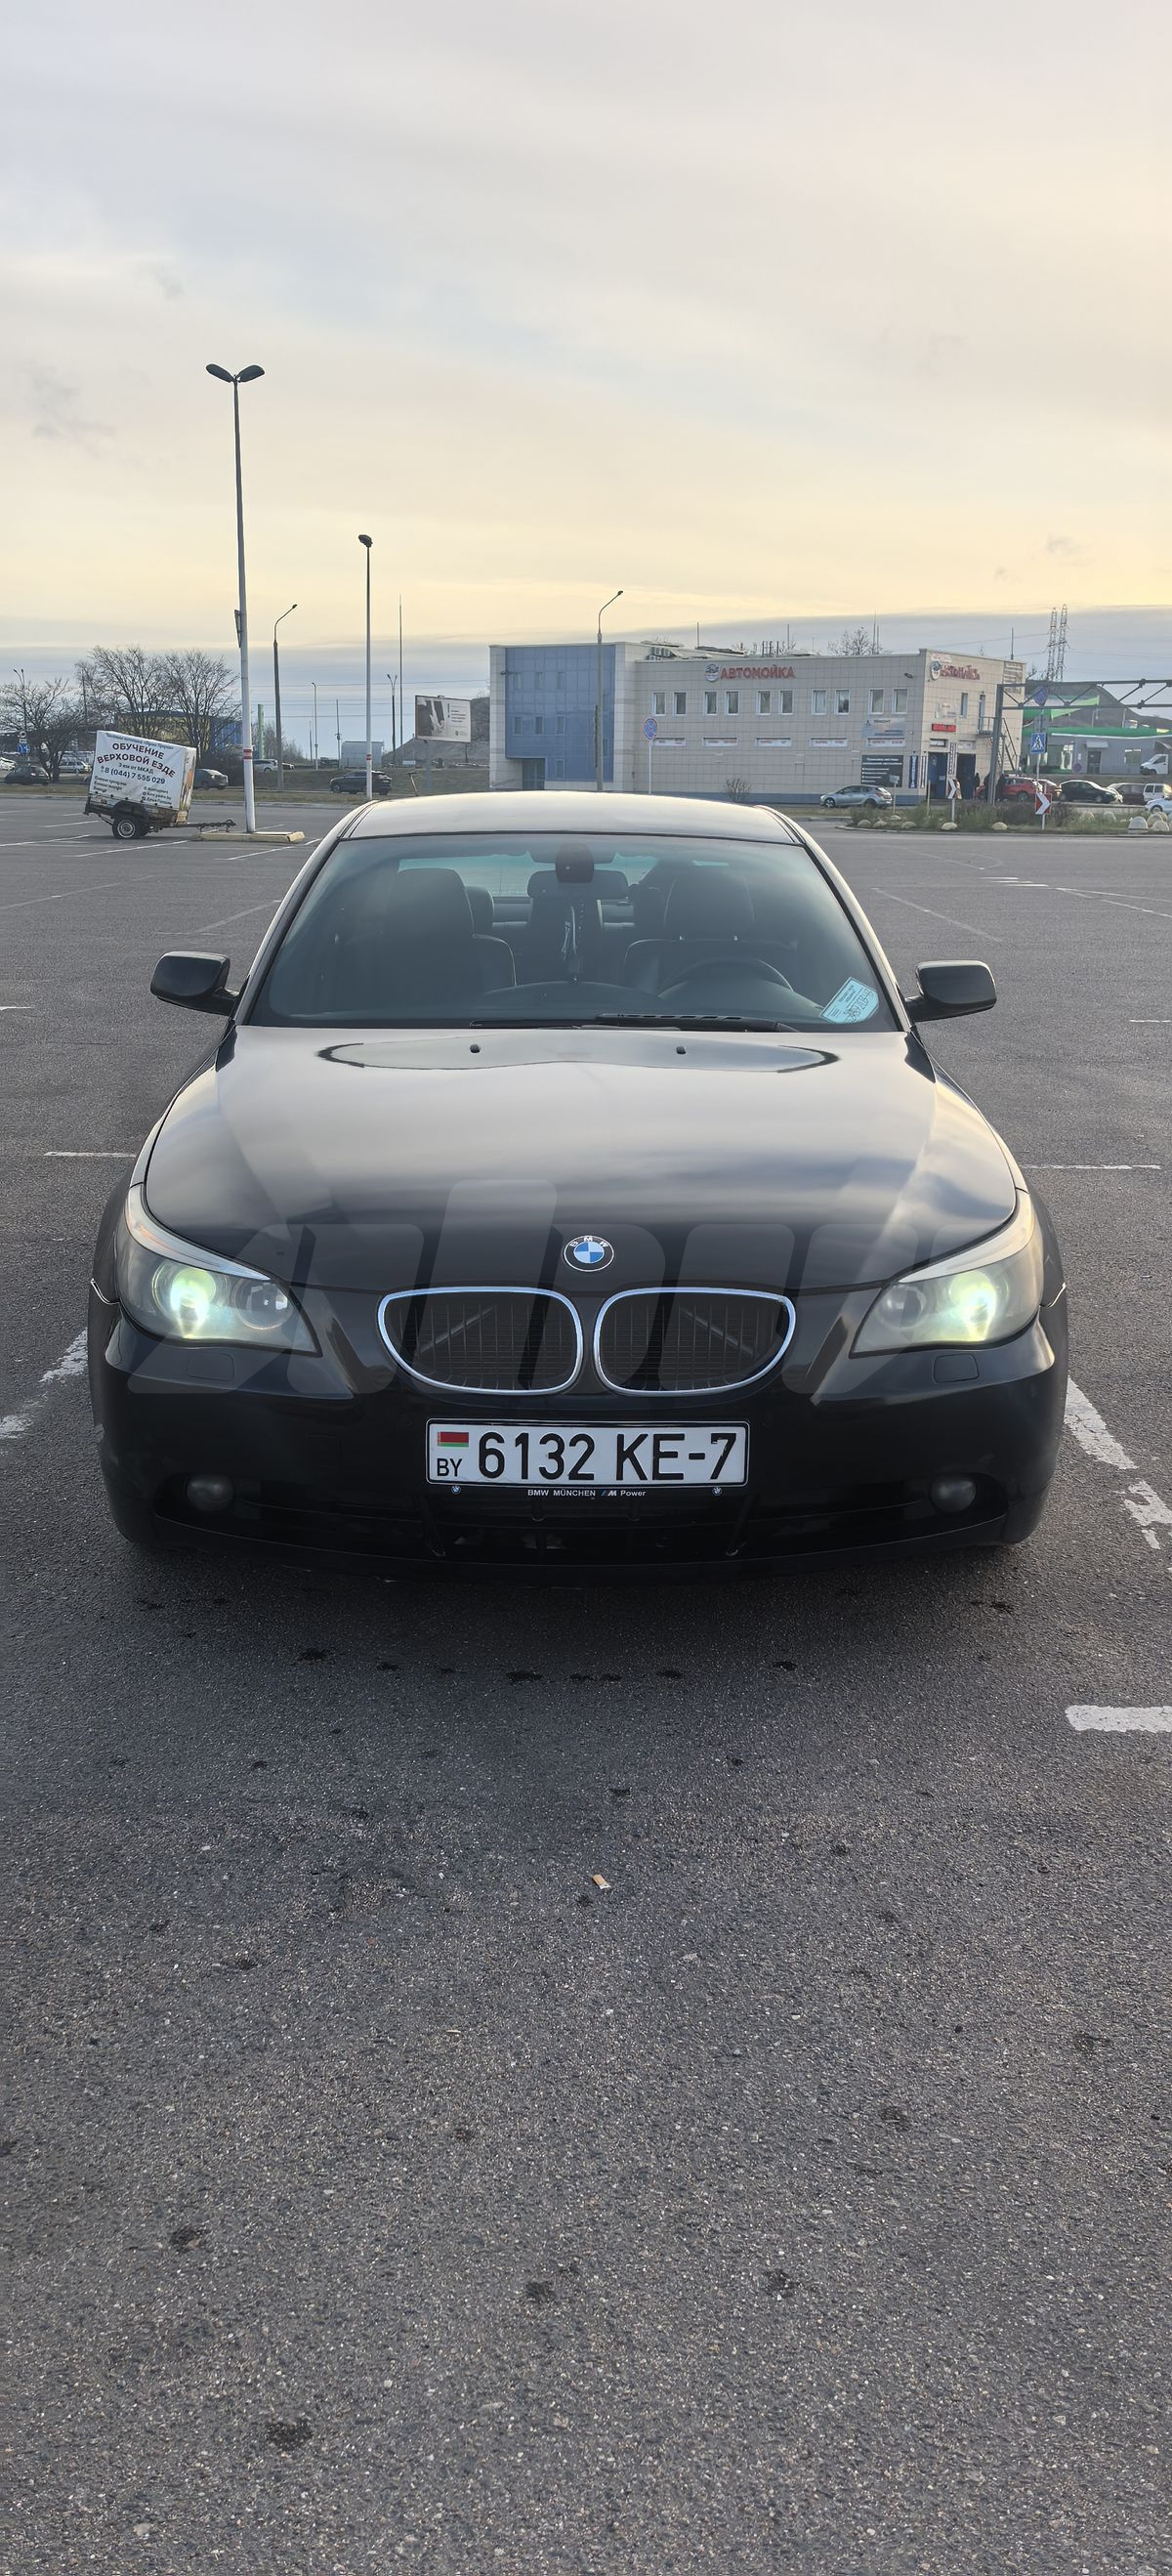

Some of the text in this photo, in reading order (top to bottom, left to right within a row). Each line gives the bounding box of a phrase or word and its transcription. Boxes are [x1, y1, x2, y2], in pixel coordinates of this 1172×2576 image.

[720, 664, 796, 680] АВТОМОЙКА
[112, 742, 164, 760] ОБУЧЕНИЕ
[97, 753, 176, 778] ВЕРХОВОЙ ЕЗДЕ
[110, 768, 130, 779] (044)
[137, 773, 150, 782] 555
[479, 1431, 736, 1481] 6132 KE-7
[437, 1457, 463, 1477] BY
[553, 1488, 596, 1497] MÜNCHEN
